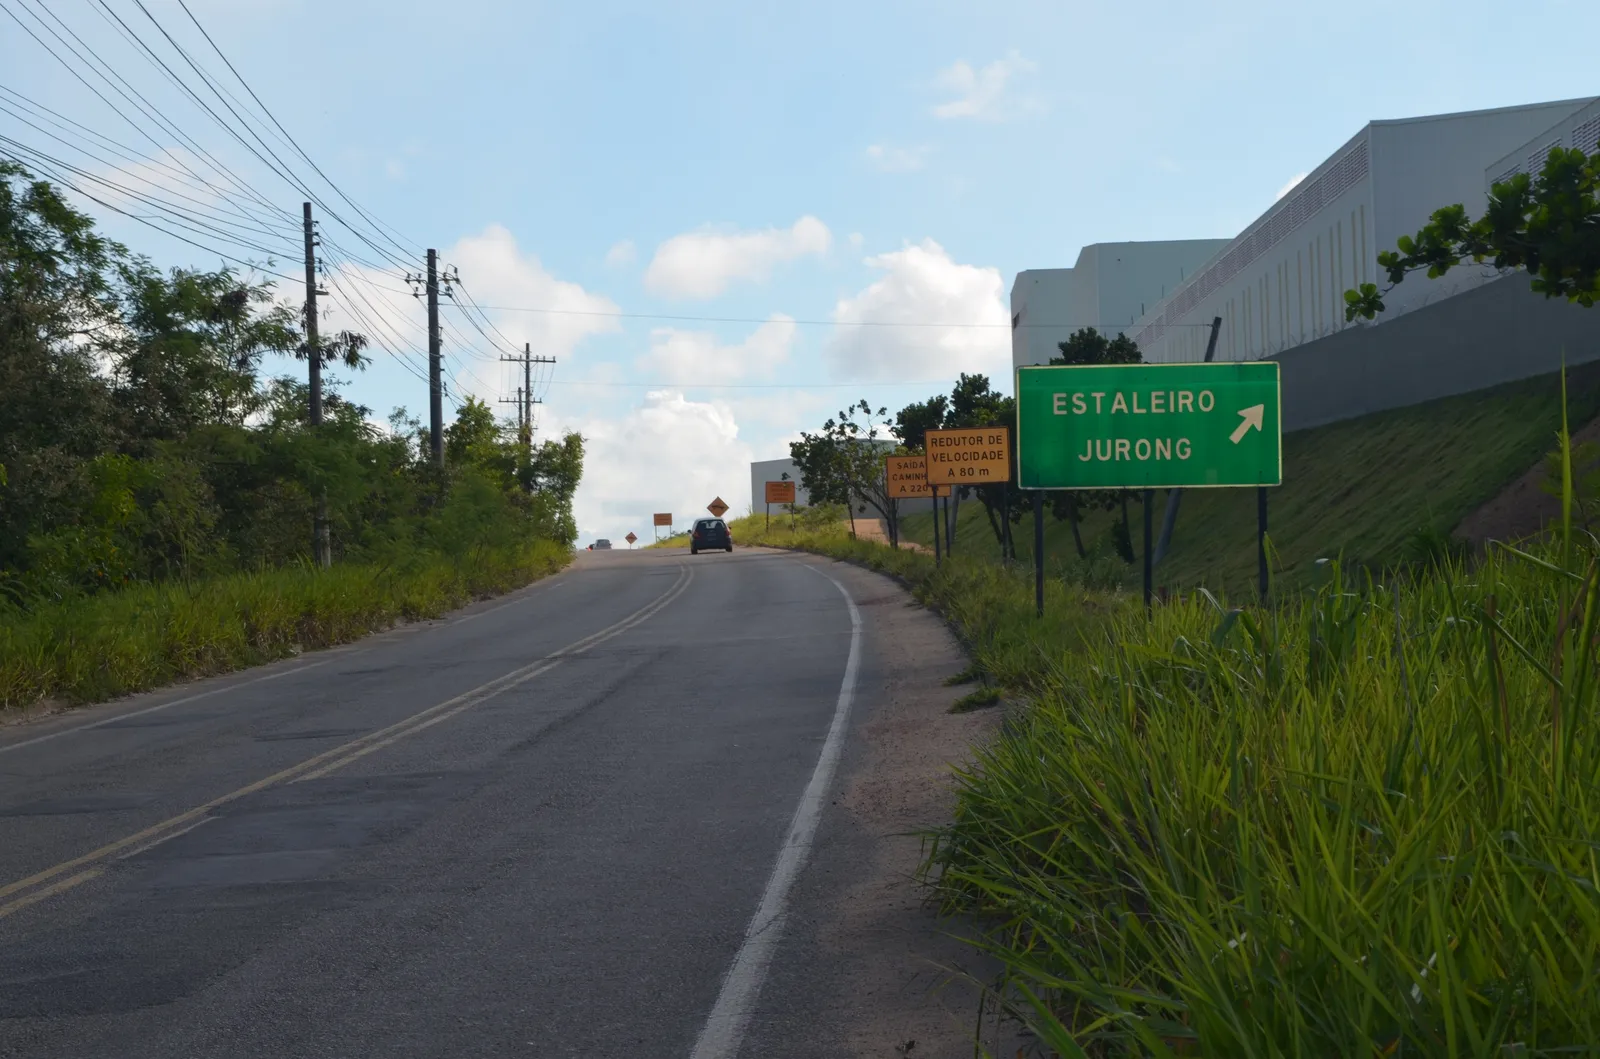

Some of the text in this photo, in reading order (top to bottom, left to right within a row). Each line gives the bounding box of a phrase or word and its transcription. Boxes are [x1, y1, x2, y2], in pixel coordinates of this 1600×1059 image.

[1053, 390, 1215, 415] ESTALEIRO
[931, 435, 1003, 447] REDUTOR DE
[932, 450, 1004, 462] VELOCIDADE
[1078, 438, 1192, 462] JURONG
[892, 473, 928, 481] CAMINH
[948, 467, 989, 477] A 80 m
[900, 485, 907, 493] A
[910, 484, 928, 492] 220
